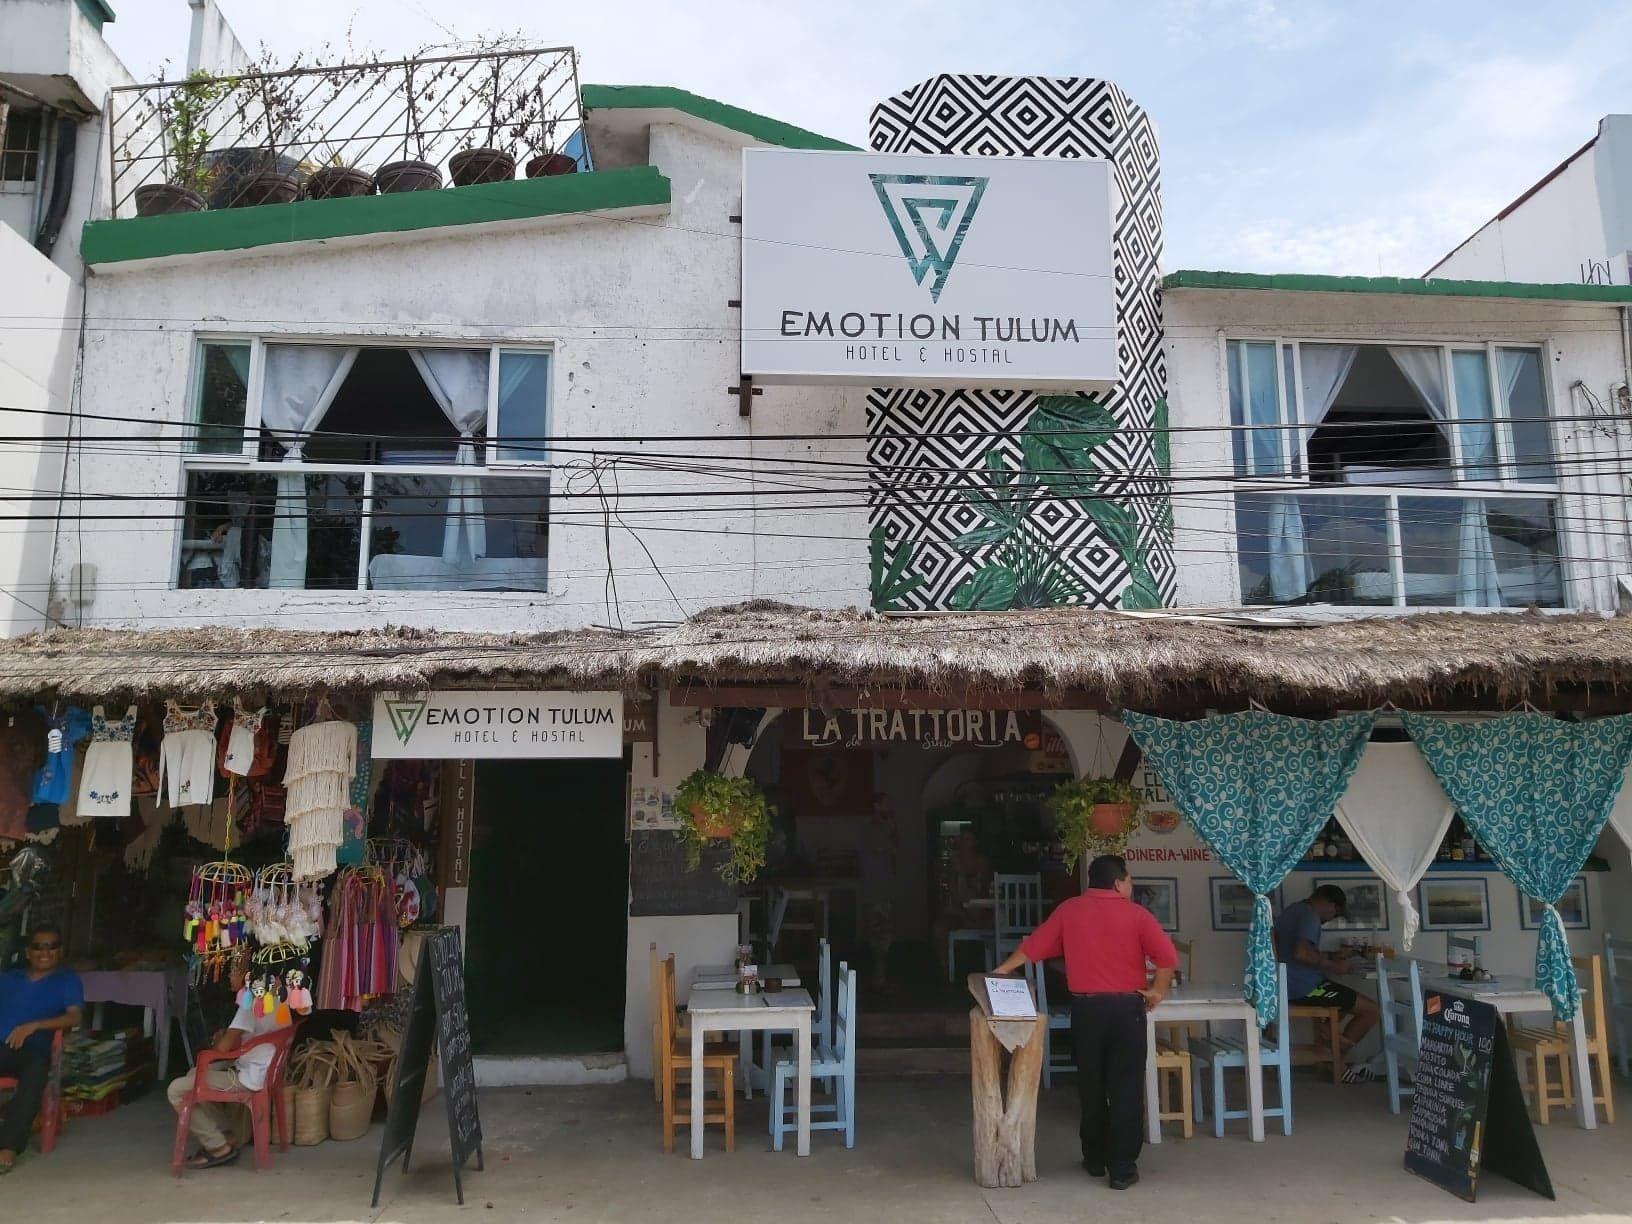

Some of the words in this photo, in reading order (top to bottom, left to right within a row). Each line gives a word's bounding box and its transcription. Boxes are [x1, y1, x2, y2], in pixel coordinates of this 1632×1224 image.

[781, 310, 960, 340] EMOTION
[973, 316, 1080, 343] TULUM
[846, 345, 902, 361] HOTEL
[944, 348, 1013, 364] HOSTAL
[426, 707, 540, 725] EMOTION
[548, 708, 614, 724] TULUM
[803, 709, 842, 741] LA
[851, 708, 1023, 742] TRATTORIA
[454, 730, 499, 743] HOTEL
[531, 730, 585, 743] HOSTAL
[455, 807, 465, 883] HOSTAL
[1444, 1008, 1471, 1025] Corona
[1454, 1028, 1473, 1045] HOUR
